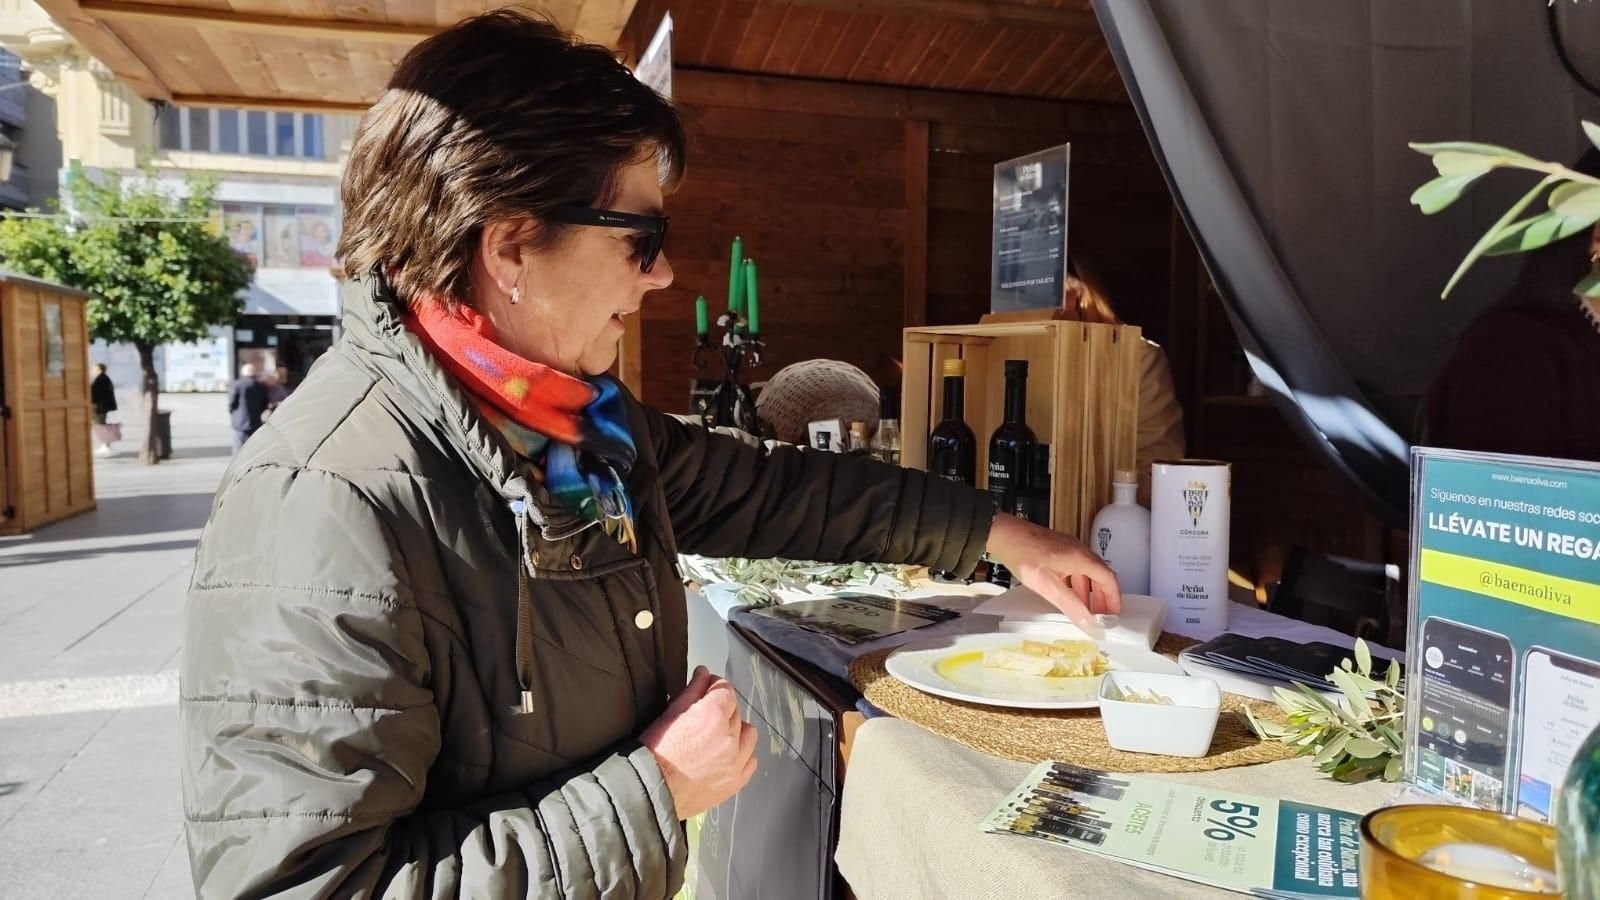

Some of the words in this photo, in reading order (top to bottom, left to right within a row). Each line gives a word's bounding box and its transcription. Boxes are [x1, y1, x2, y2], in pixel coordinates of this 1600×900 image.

[1491, 473, 1568, 489] www.baenaoliva.com
[1431, 487, 1476, 505] Síguenos
[1478, 496, 1491, 507] en
[1493, 498, 1541, 515] nuestras
[1543, 506, 1576, 521] redes
[1429, 512, 1512, 543] LLÉVATE
[1514, 527, 1543, 549] UN
[1182, 583, 1204, 593] Peña
[1186, 592, 1208, 600] Baena
[1479, 571, 1572, 605] @baenaoliva
[1125, 801, 1153, 835] ACEITES
[1191, 796, 1206, 822] descuento
[1203, 799, 1260, 841] 5%
[1296, 813, 1310, 834] como
[1317, 813, 1332, 836] marca
[1318, 837, 1335, 851] tan
[1340, 836, 1360, 846] de
[1291, 834, 1316, 881] excepcional
[1318, 851, 1338, 887] cotidiana
[1343, 872, 1358, 887] una
